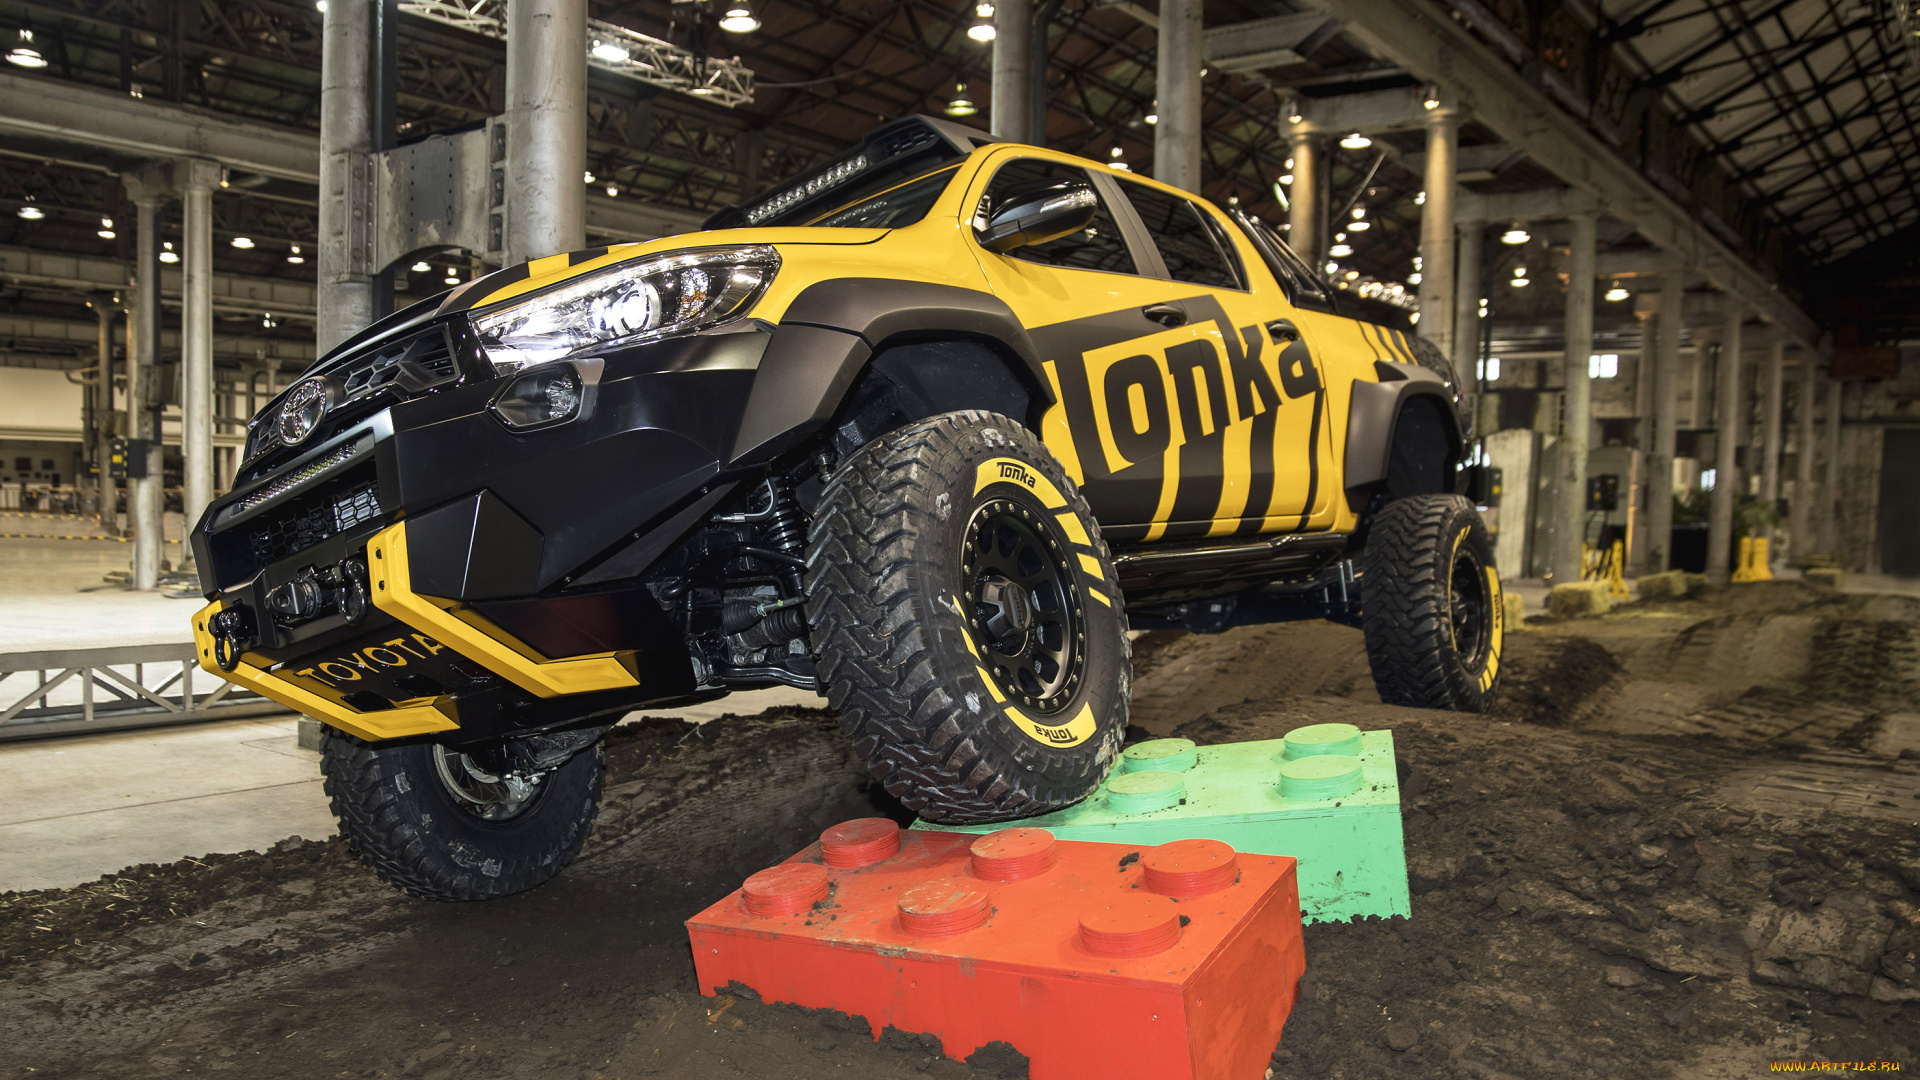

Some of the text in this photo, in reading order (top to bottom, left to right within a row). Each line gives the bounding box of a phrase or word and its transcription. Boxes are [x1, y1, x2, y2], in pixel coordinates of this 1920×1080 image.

[1026, 294, 1325, 486] Tonka
[996, 461, 1037, 489] Tonka
[294, 633, 445, 688] TOYOTA
[1033, 724, 1079, 744] Tonka
